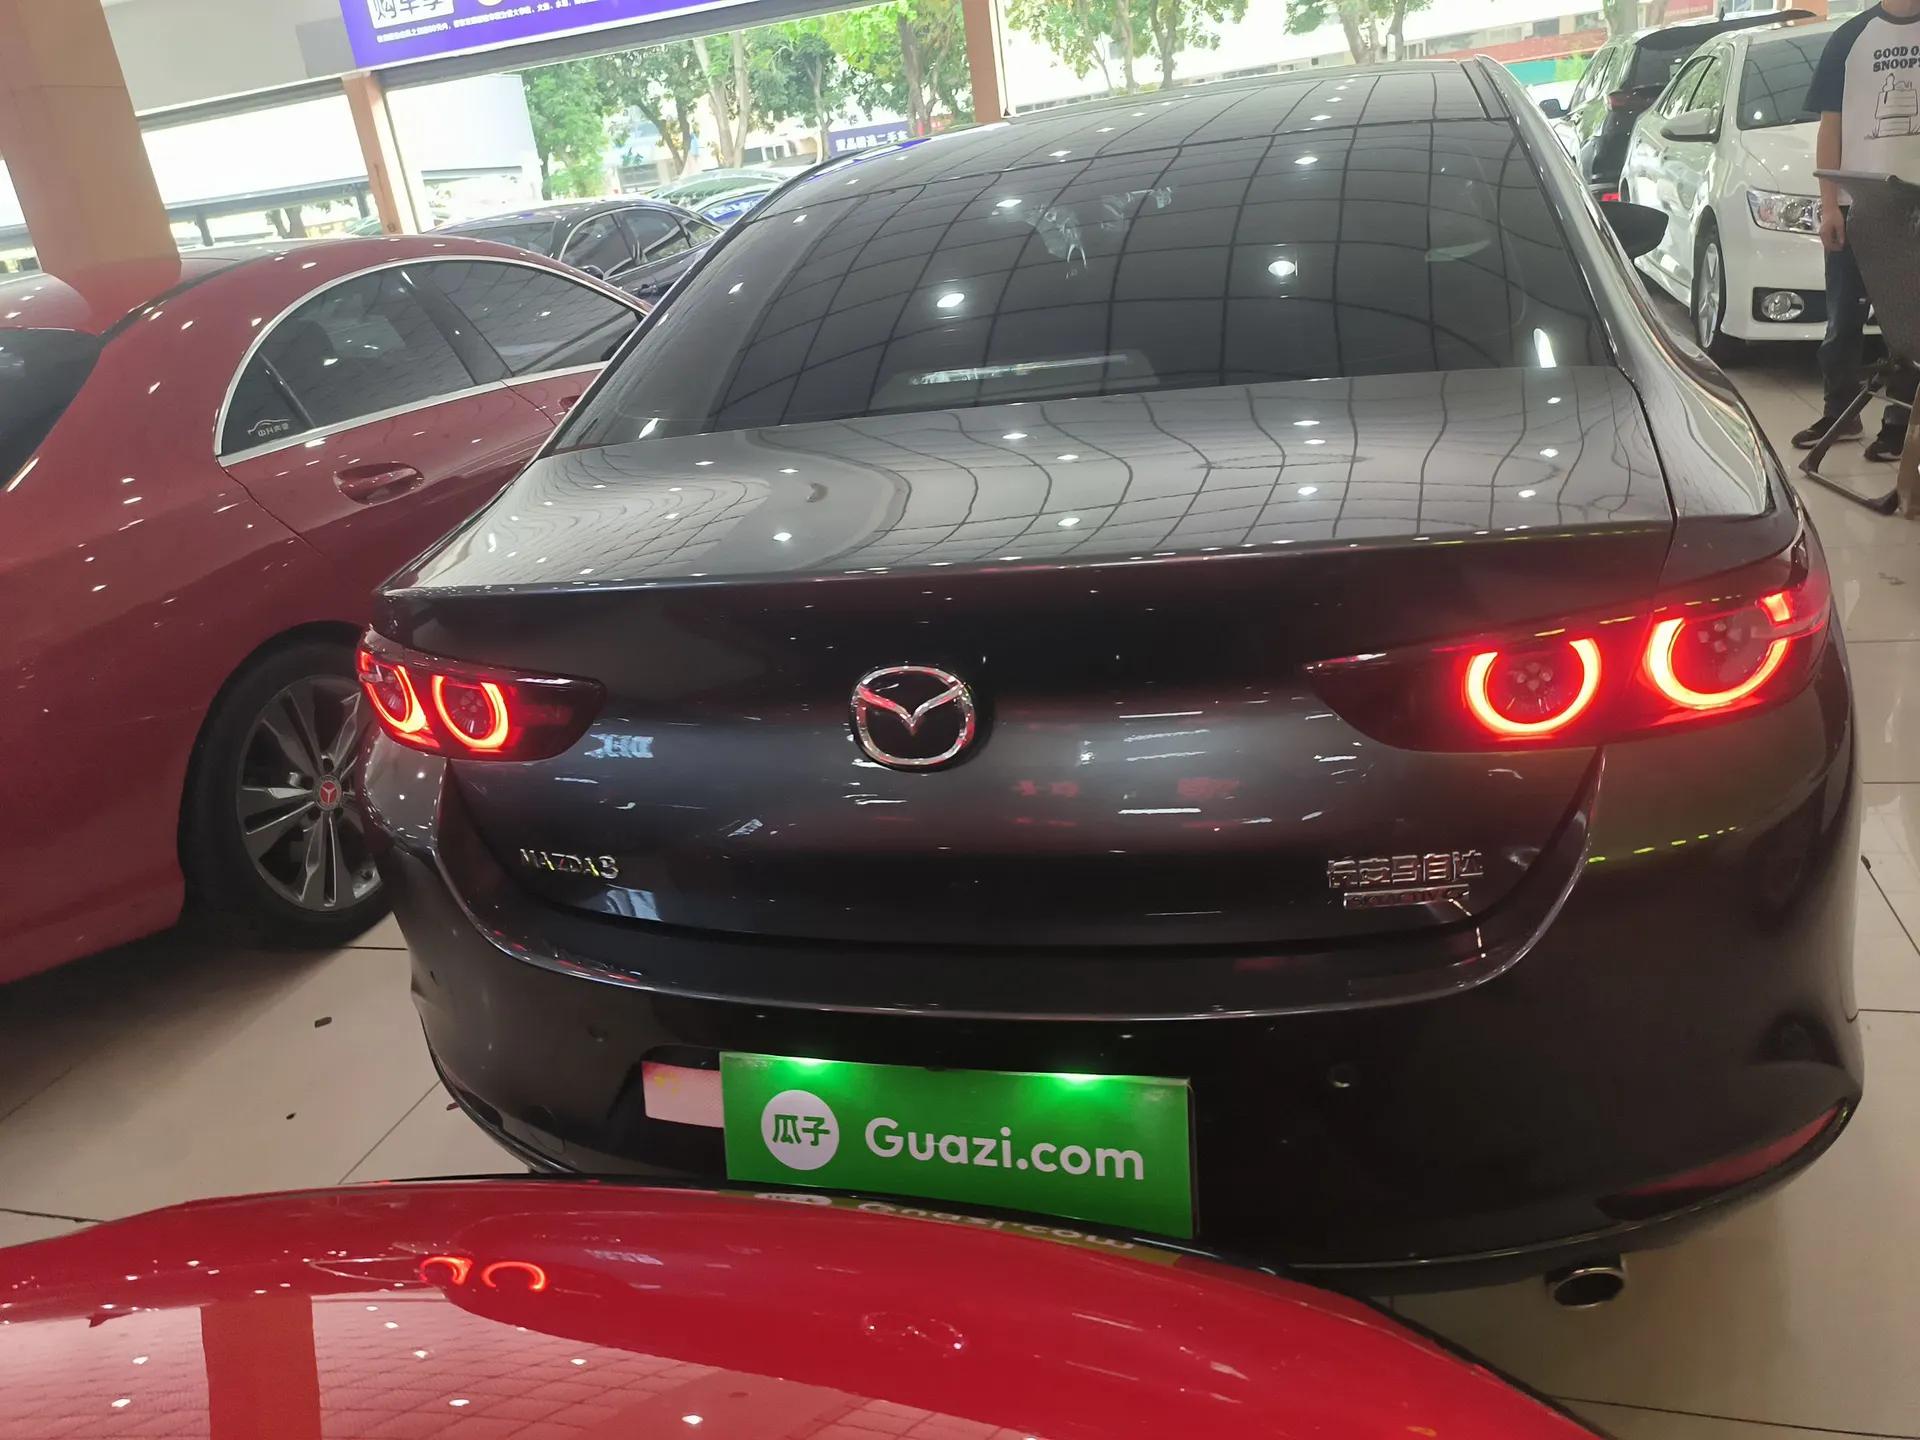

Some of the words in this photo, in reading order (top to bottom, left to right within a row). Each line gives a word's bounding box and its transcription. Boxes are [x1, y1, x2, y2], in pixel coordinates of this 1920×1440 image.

[1873, 46, 1909, 60] GOOD
[1910, 45, 1920, 57] O
[1327, 850, 1485, 888] 长安马自达
[772, 1114, 831, 1147] 瓜子
[864, 1116, 1145, 1181] Guazi.com
